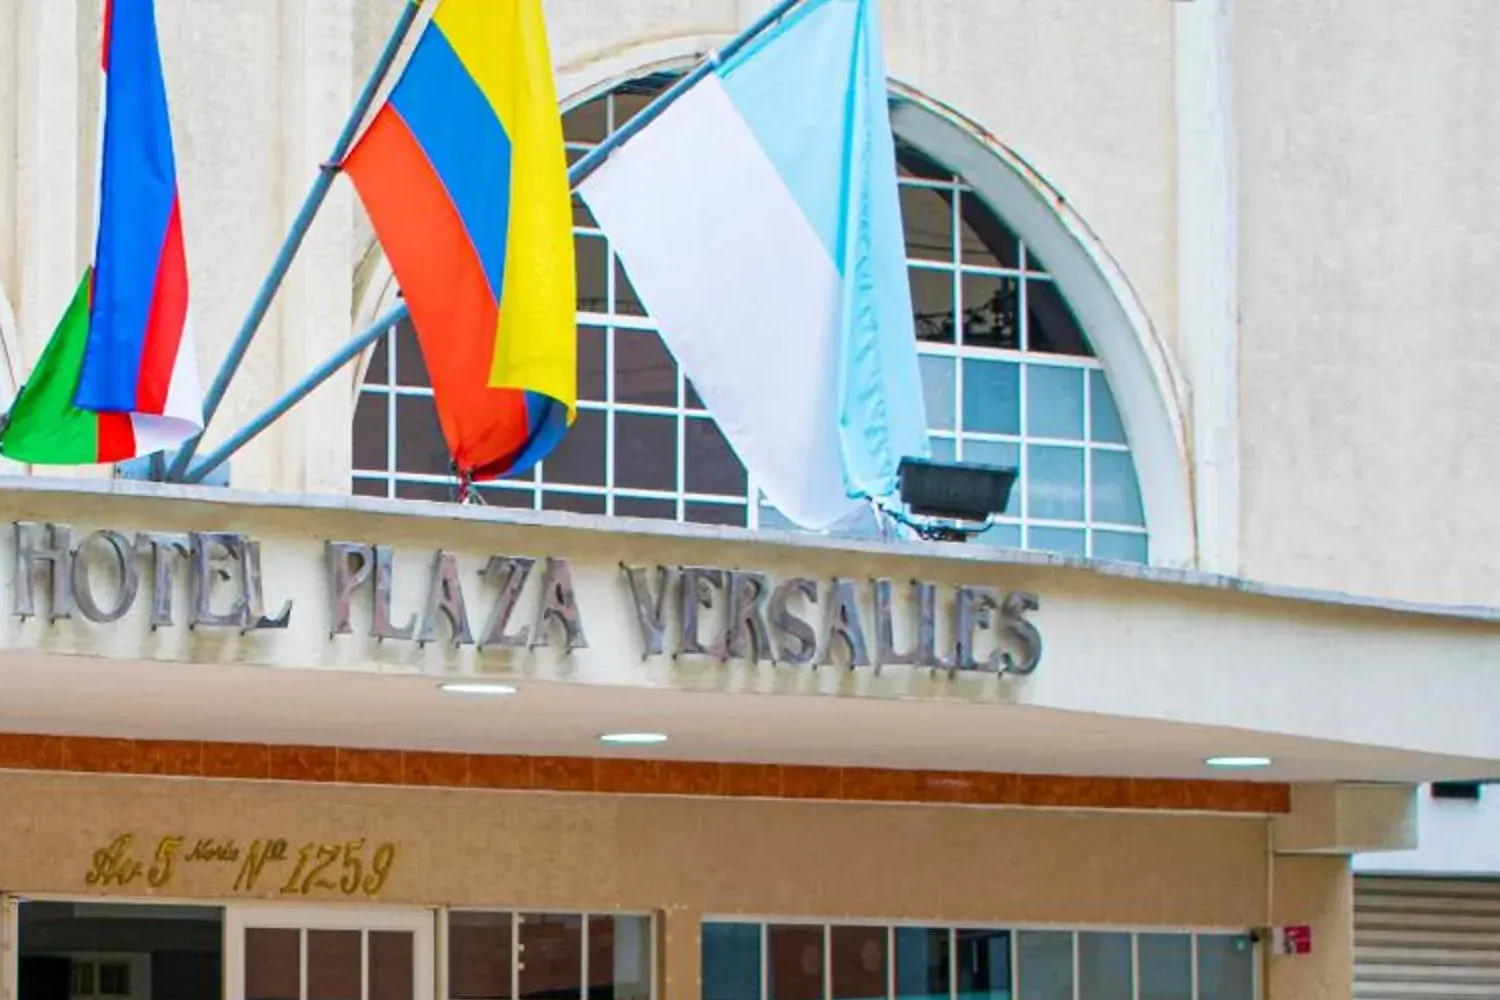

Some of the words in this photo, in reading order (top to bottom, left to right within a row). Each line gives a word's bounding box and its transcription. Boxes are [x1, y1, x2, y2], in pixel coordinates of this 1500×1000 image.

[12, 521, 293, 634] HOTEL
[325, 540, 589, 653] PLAZA
[619, 562, 1043, 679] VERSALLES
